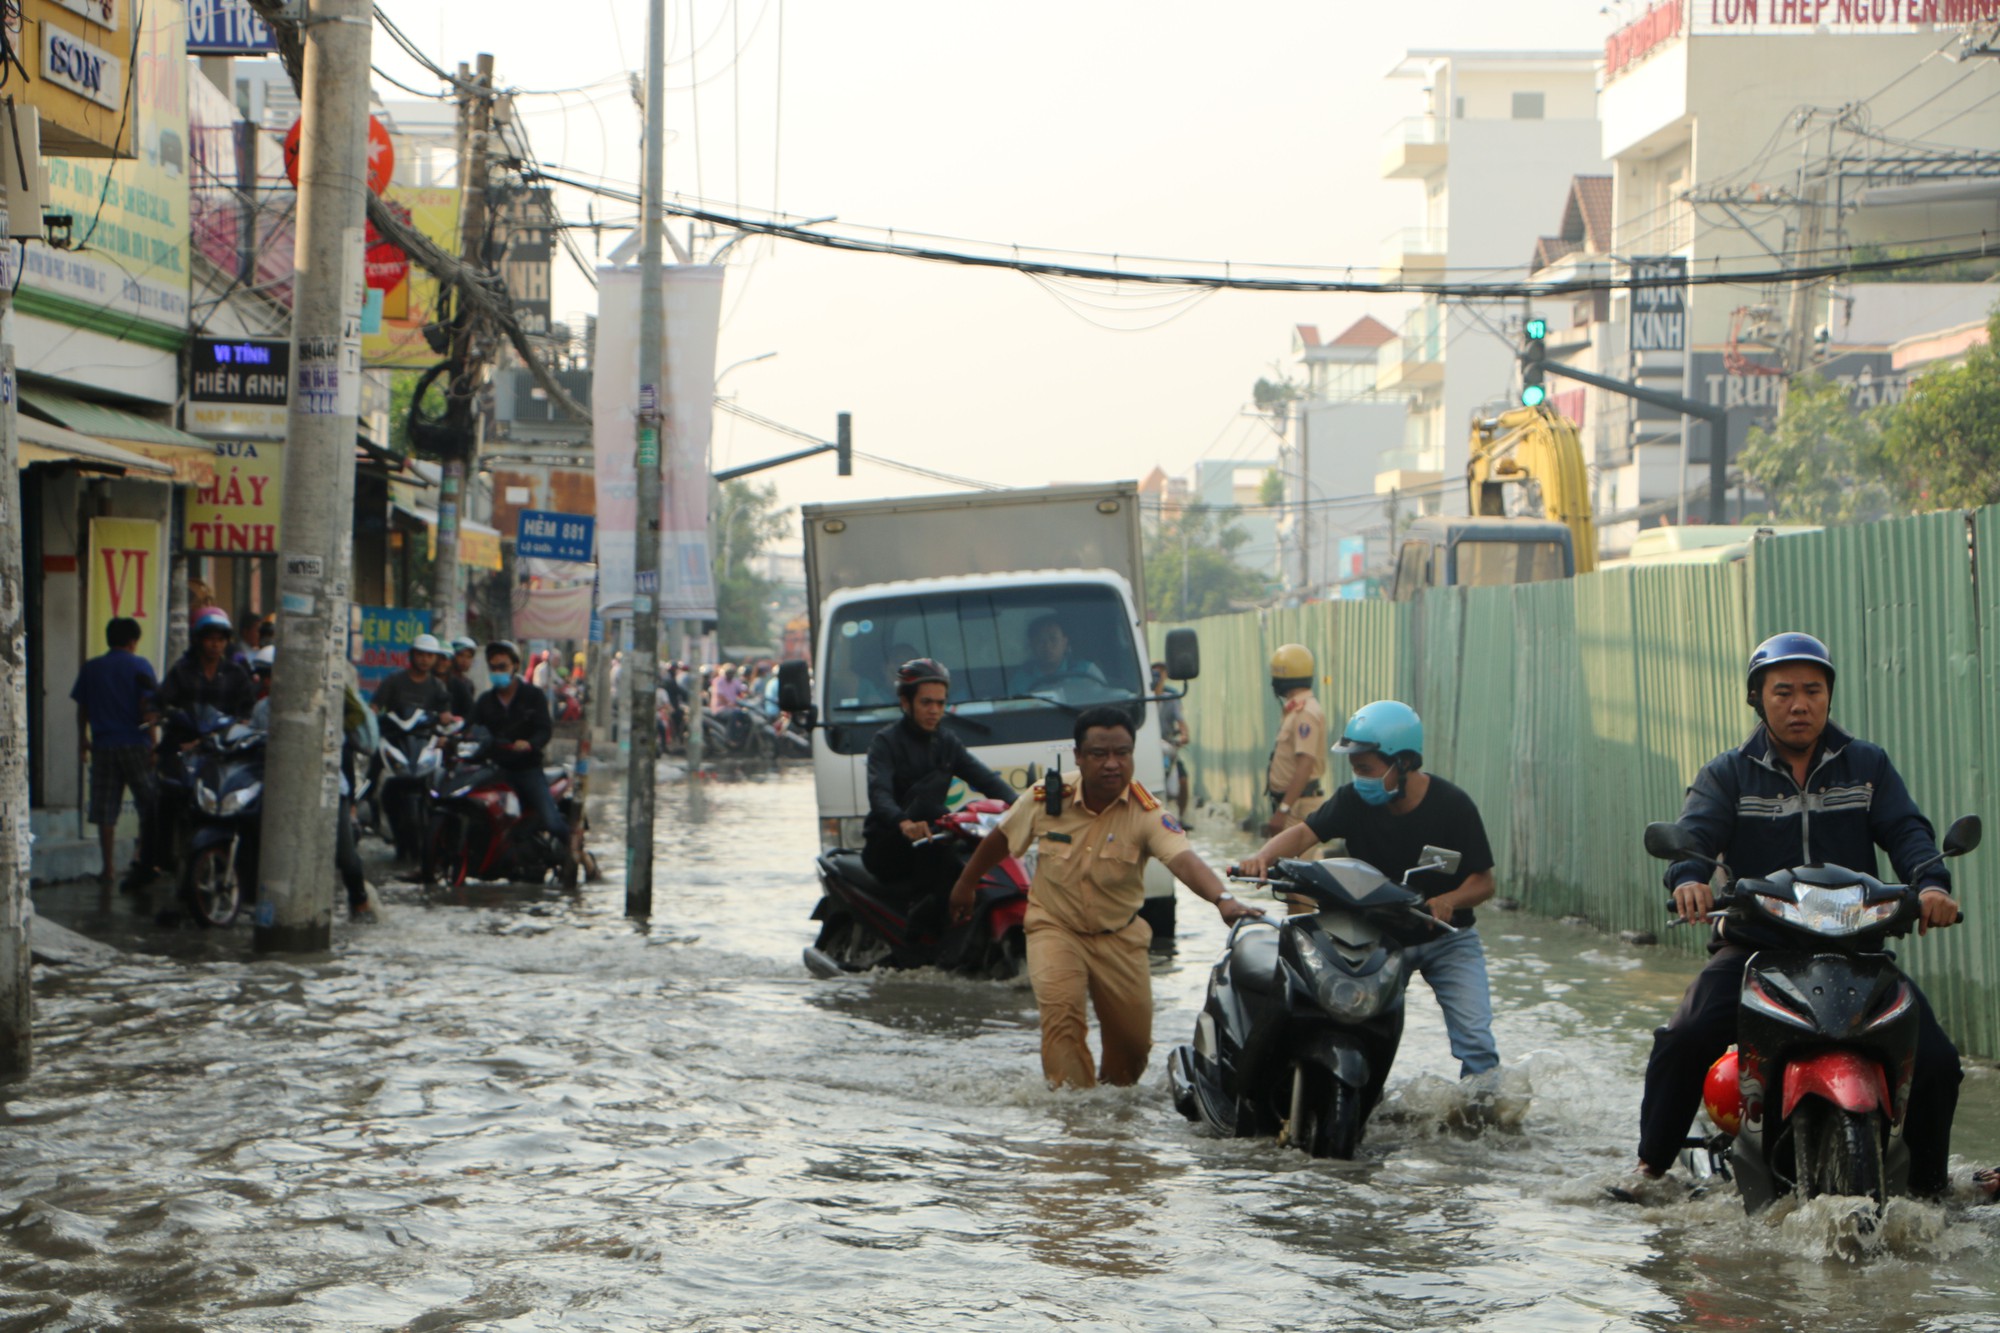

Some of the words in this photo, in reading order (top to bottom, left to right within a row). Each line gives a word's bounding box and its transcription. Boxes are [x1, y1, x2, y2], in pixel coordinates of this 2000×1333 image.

[245, 373, 286, 398] ANH
[197, 465, 270, 507] MÁY
[190, 513, 276, 552] TÍNH
[562, 522, 585, 542] 881
[101, 547, 149, 618] VI
